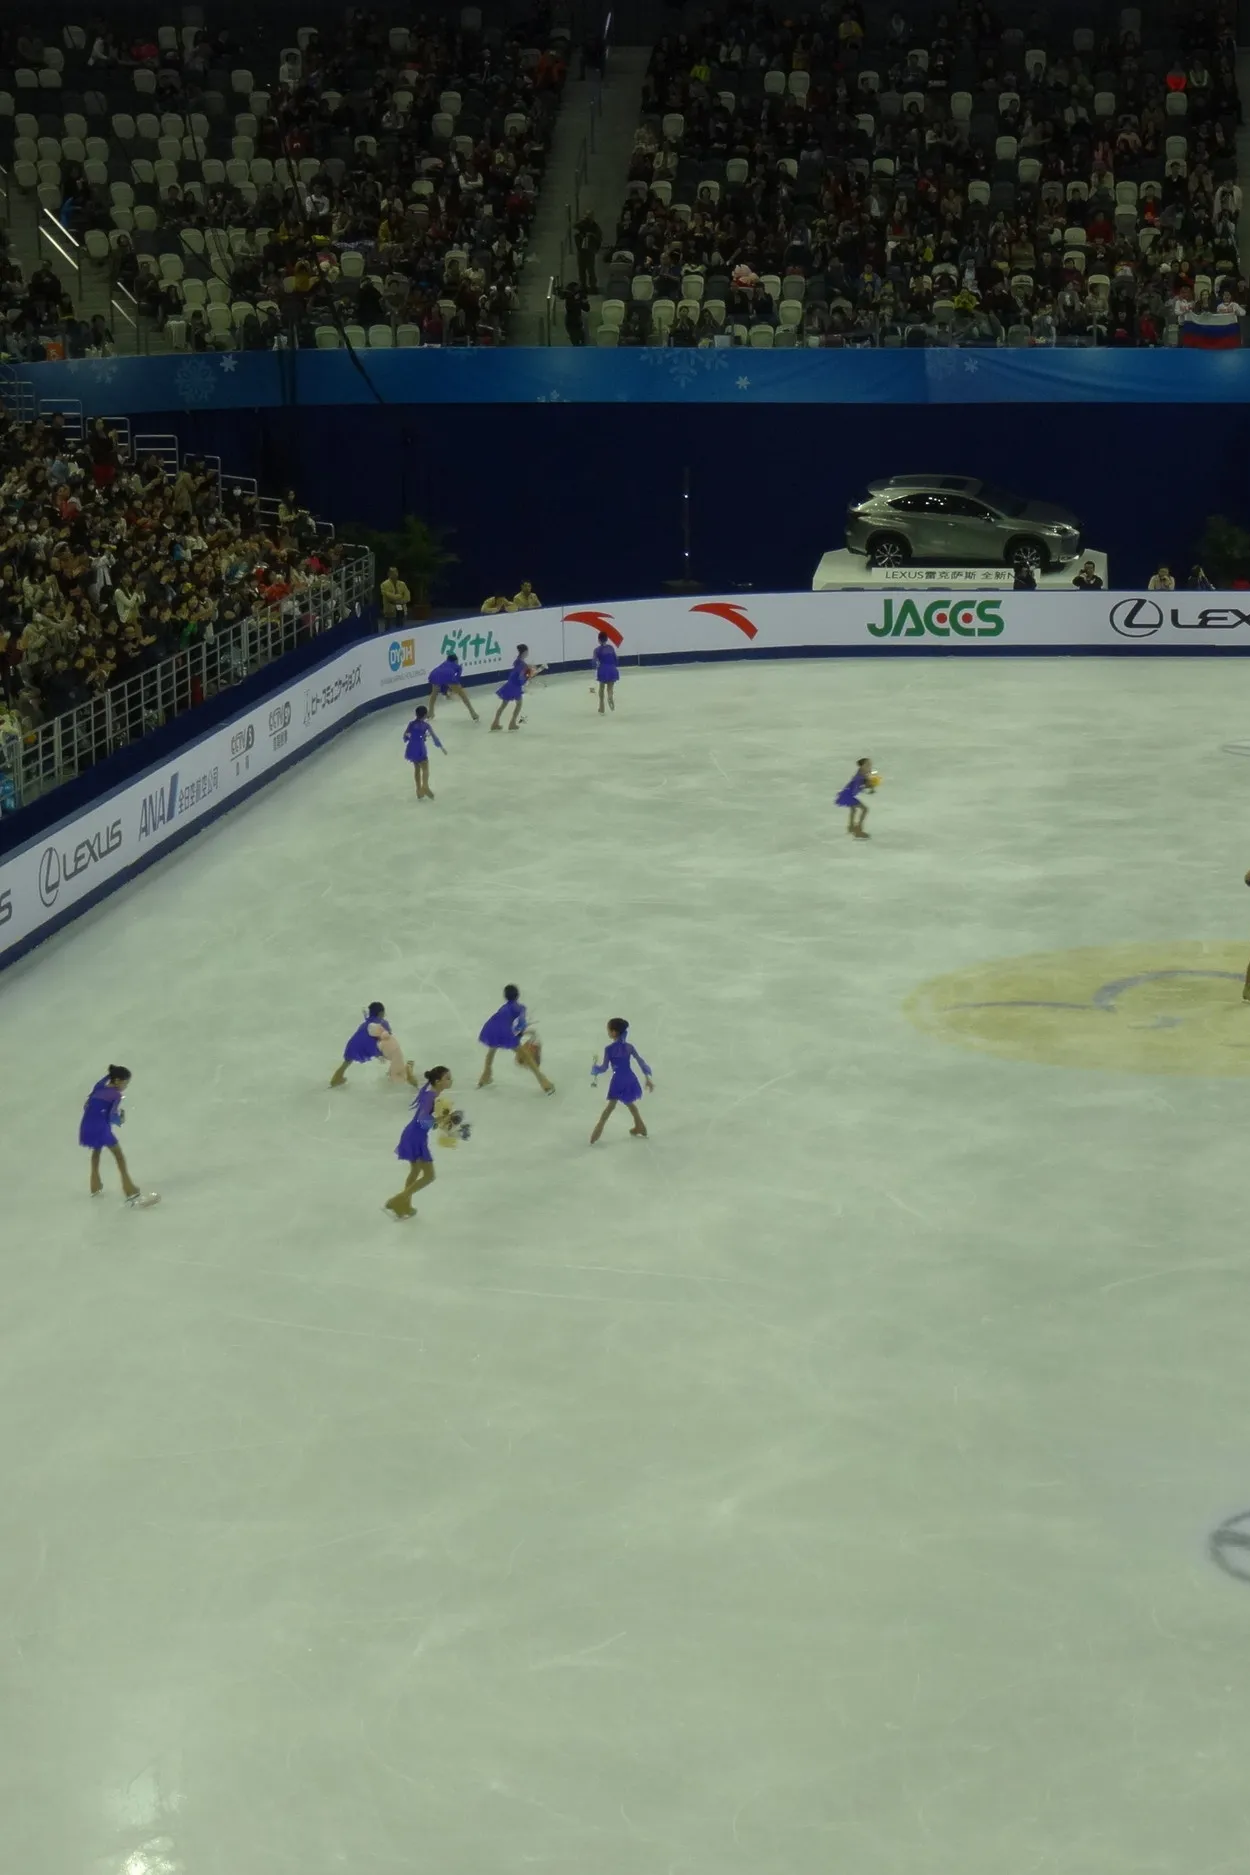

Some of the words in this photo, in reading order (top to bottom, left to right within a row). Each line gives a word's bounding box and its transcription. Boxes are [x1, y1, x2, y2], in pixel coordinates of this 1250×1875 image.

[866, 598, 1006, 638] JACCS
[440, 628, 502, 661] ダイナム
[138, 786, 166, 842] ANA
[62, 817, 123, 882] LEXUS
